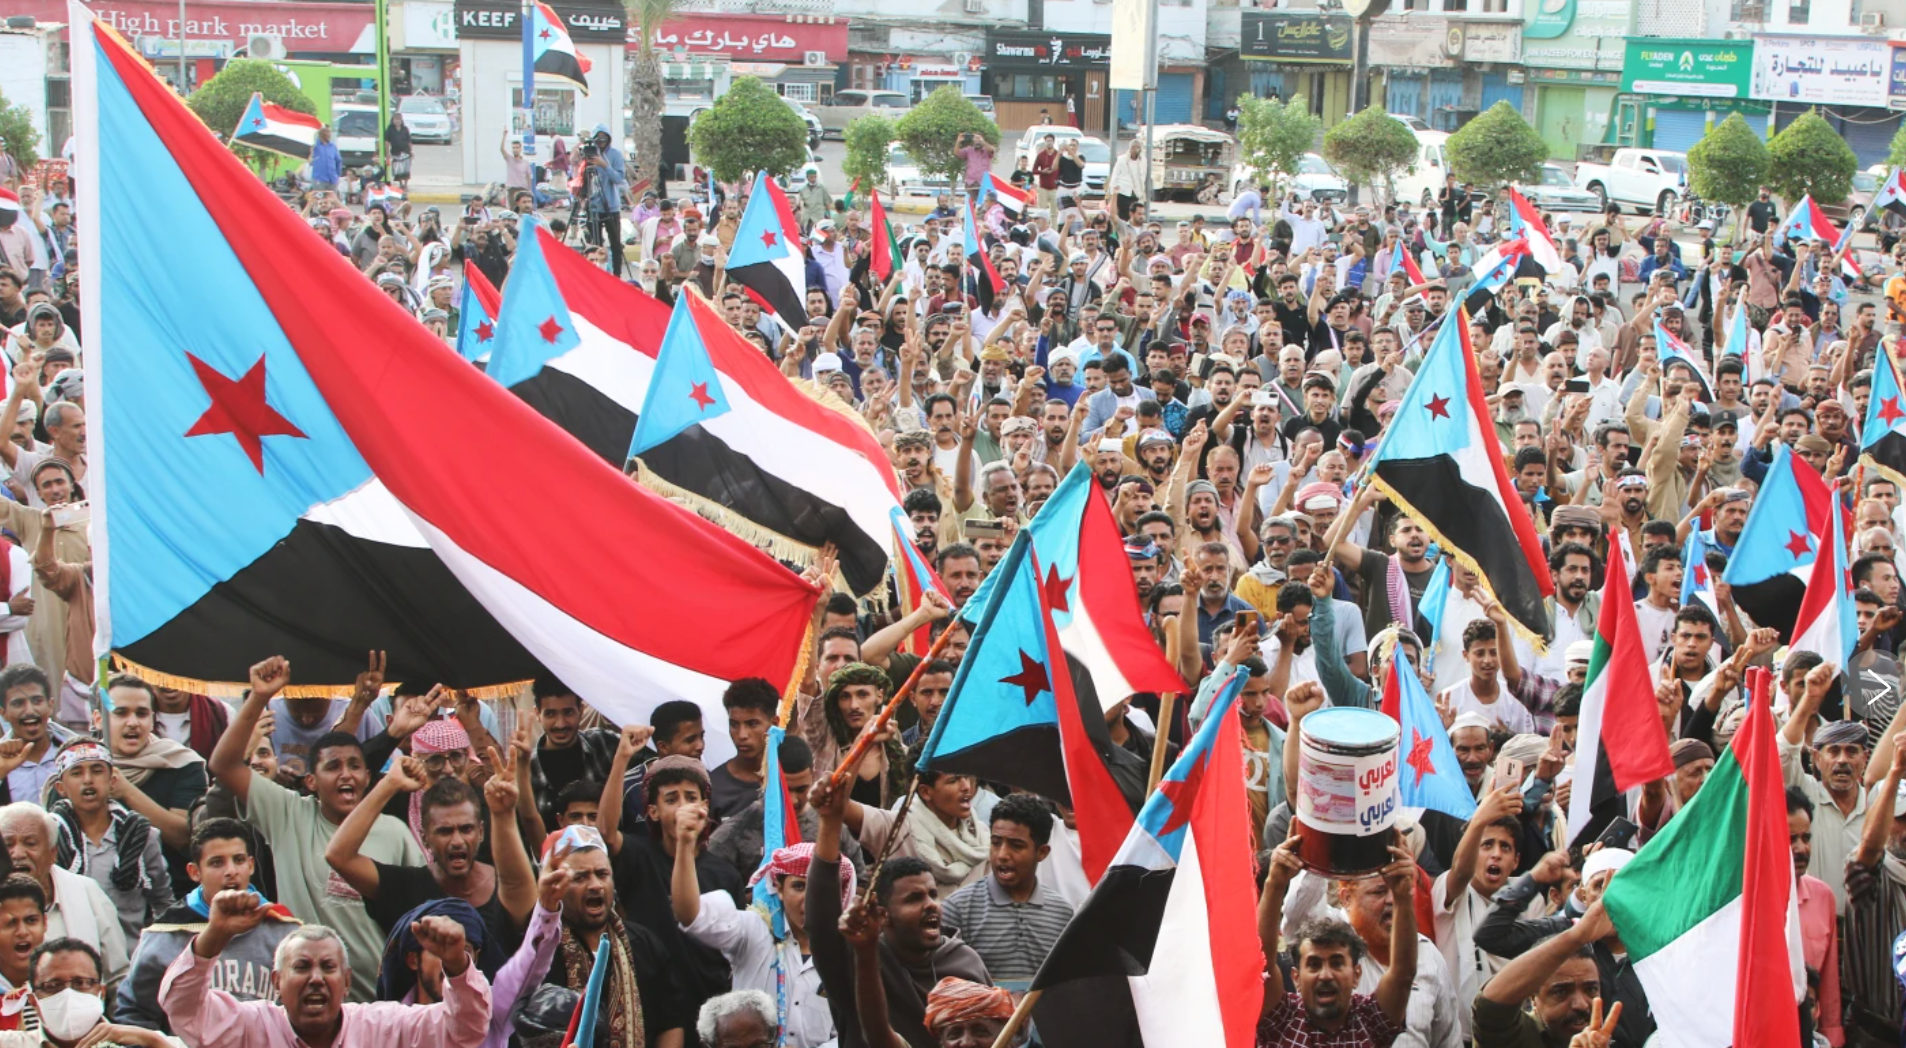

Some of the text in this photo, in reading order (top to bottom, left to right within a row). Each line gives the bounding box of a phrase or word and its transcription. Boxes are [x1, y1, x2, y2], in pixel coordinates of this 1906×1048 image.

[96, 10, 329, 39] High park market
[463, 11, 515, 27] KEEF
[684, 29, 749, 50] بارك
[752, 33, 797, 54] هاي
[1771, 53, 1825, 79] للتجارة
[1829, 58, 1883, 84] باعبيد
